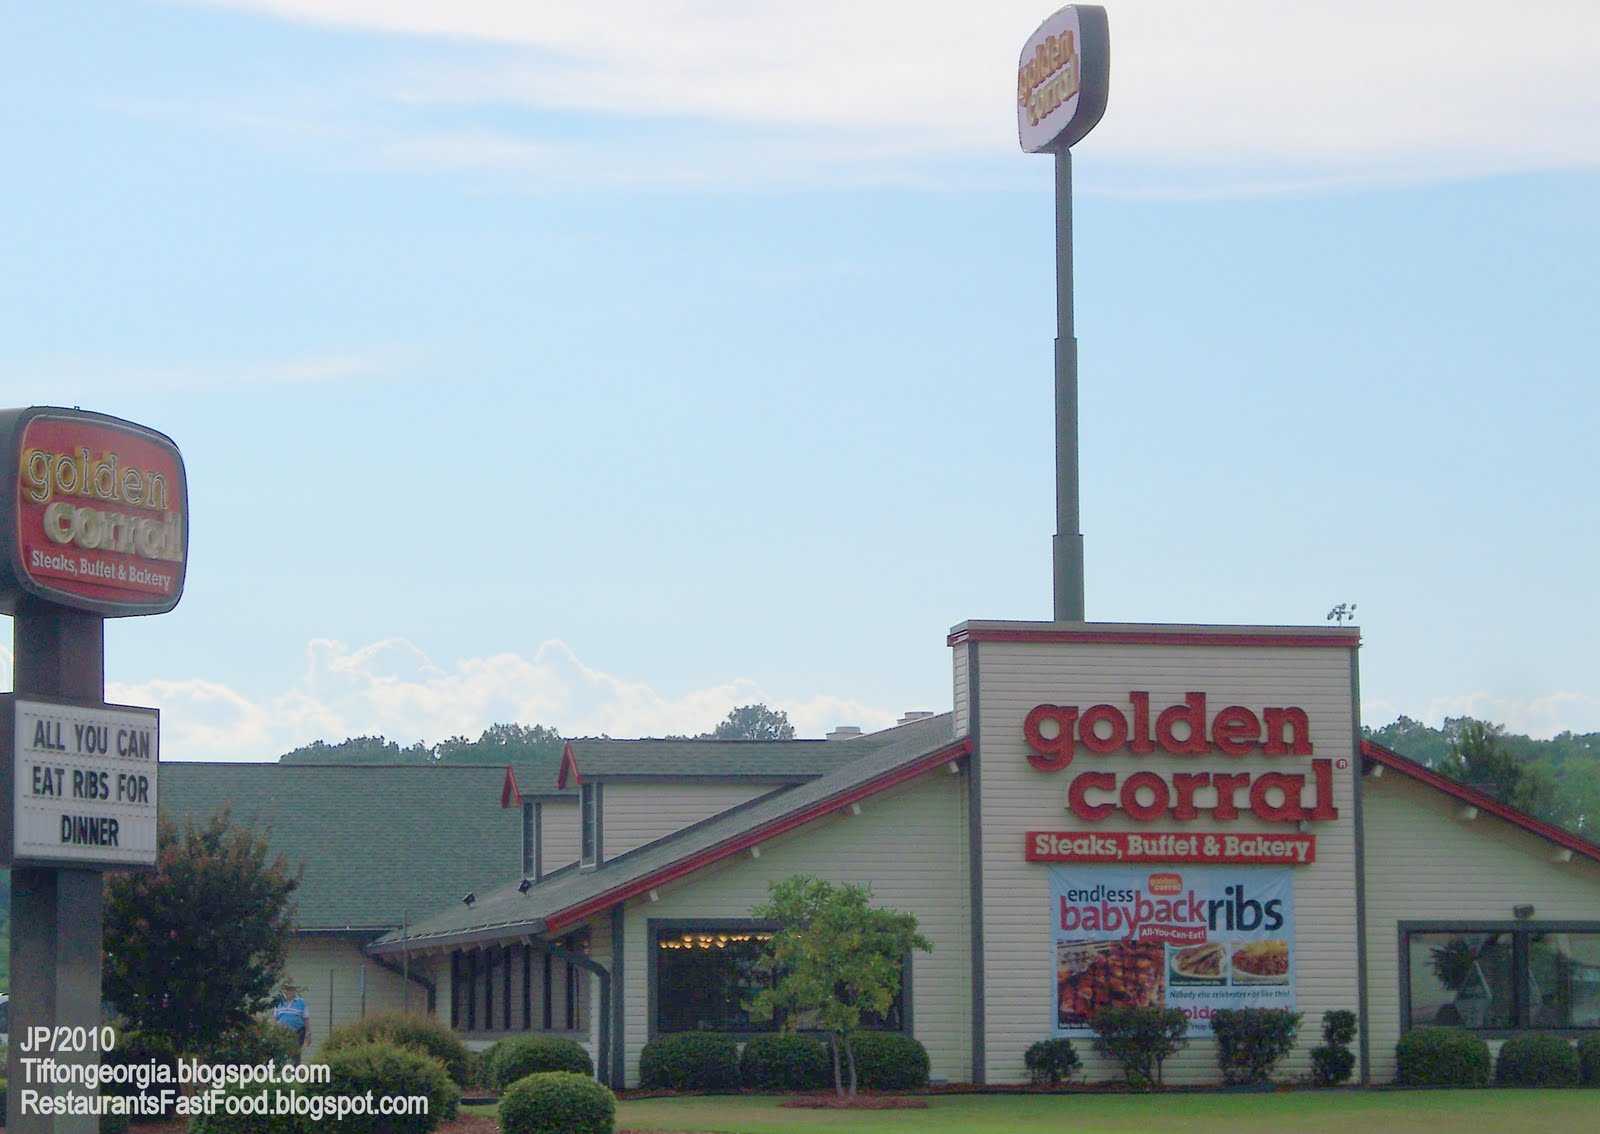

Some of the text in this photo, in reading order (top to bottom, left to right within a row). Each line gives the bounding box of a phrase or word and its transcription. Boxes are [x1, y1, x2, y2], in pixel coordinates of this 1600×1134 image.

[22, 447, 168, 510] golden
[44, 501, 183, 562] corral
[32, 550, 171, 589] Steaks, Buffet & Bakery
[33, 719, 150, 759] ALL YOU CAN
[1024, 691, 1313, 772] golden
[32, 766, 149, 803] EAT RIBS FOR
[1068, 758, 1338, 821] corral
[61, 814, 119, 846] DINNER
[1035, 834, 1310, 862] Steaks, Buffet & Bakery
[1067, 885, 1134, 902] endless
